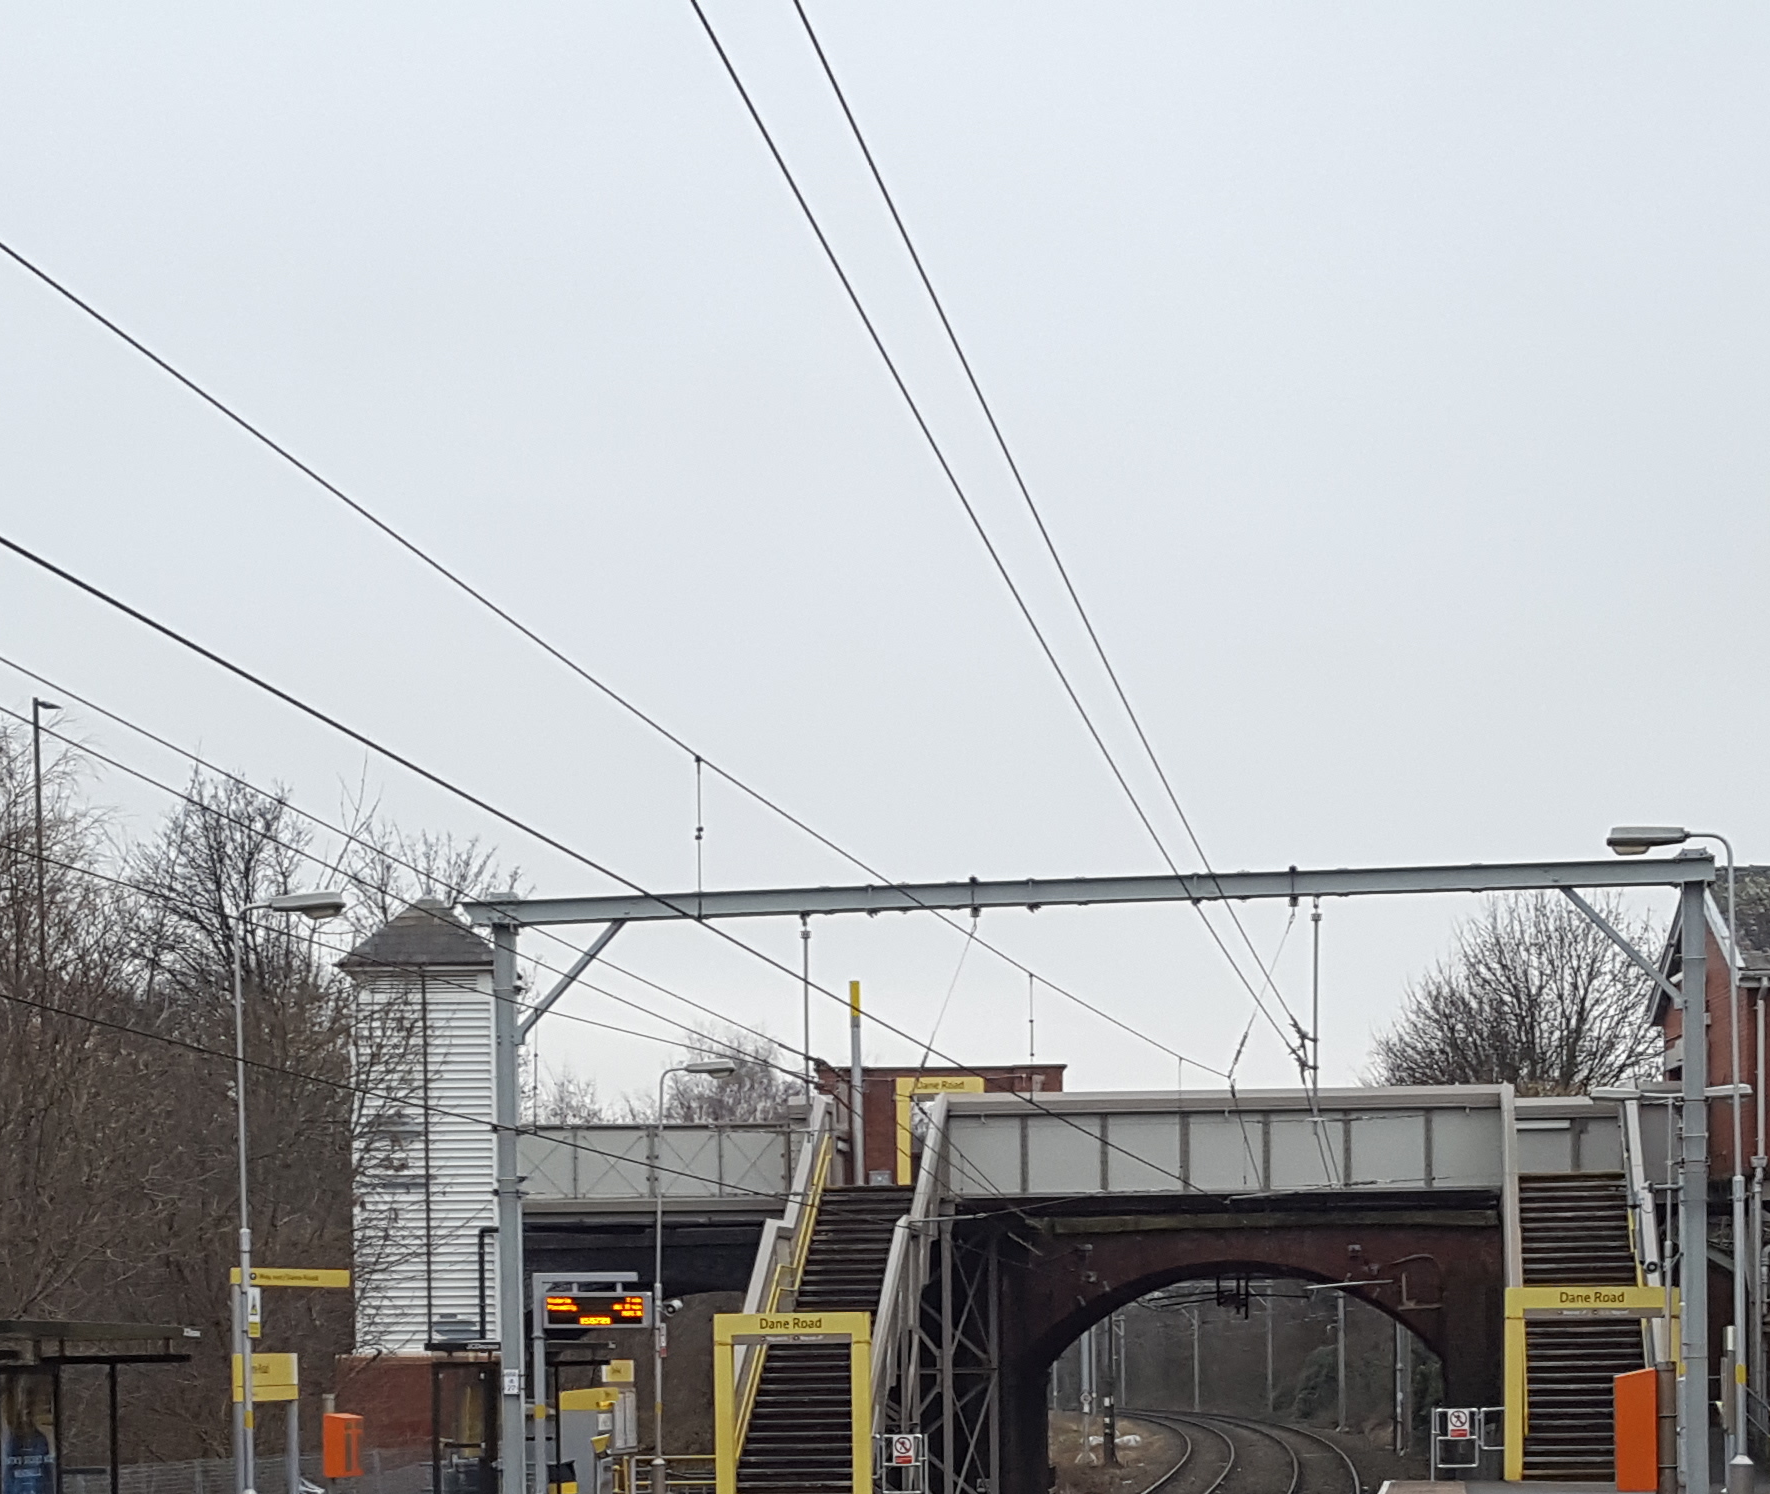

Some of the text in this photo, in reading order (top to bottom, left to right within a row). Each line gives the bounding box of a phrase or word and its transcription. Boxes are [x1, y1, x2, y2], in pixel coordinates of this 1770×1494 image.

[1559, 1291, 1625, 1303] Dane Road
[759, 1317, 823, 1330] Dane Road
